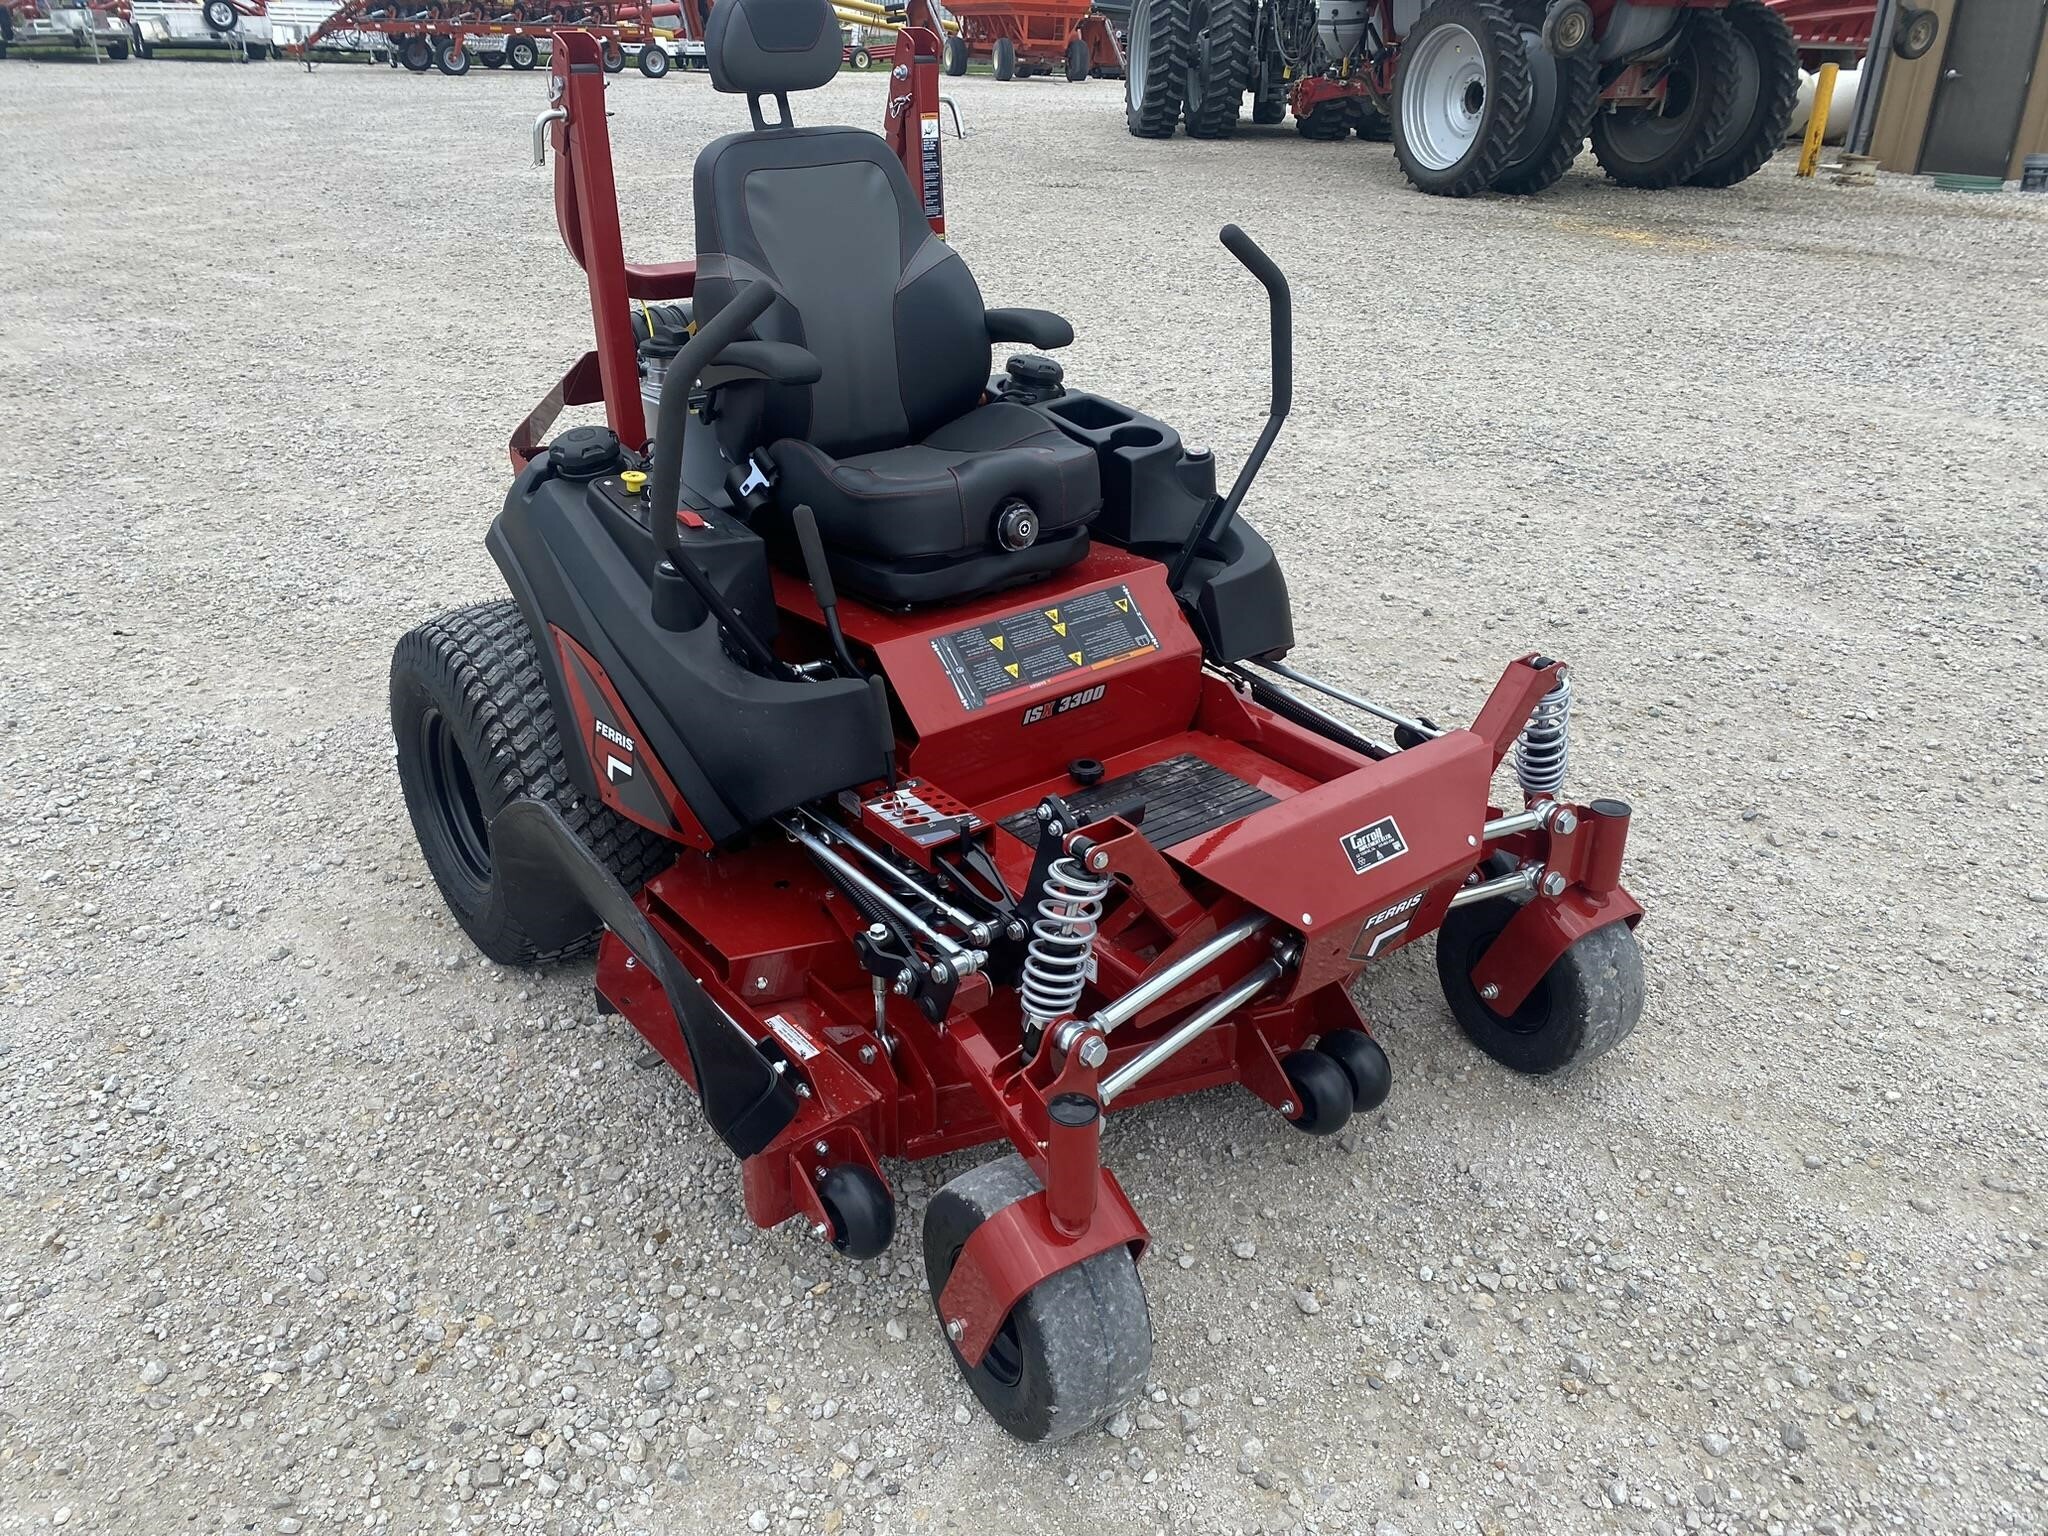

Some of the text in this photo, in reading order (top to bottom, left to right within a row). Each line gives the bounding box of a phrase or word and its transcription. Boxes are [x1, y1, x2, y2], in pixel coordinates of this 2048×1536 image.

[1023, 685, 1105, 725] ISX 3300
[596, 719, 634, 752] FERRIS
[1349, 826, 1382, 849] Carroll
[1365, 893, 1422, 930] FERRIS
